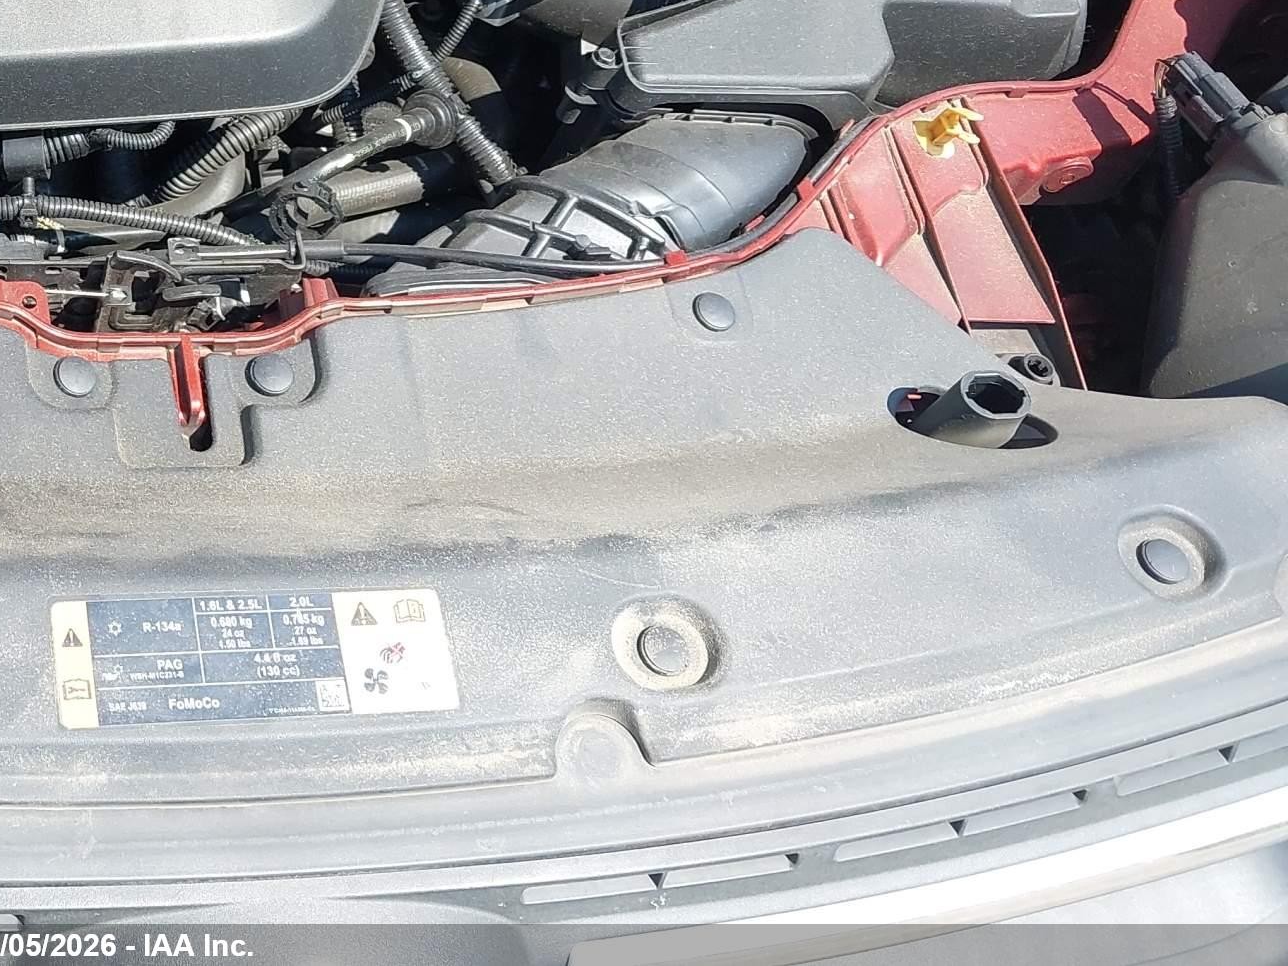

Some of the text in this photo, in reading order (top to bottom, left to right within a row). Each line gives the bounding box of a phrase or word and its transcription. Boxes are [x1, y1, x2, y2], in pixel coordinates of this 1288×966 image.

[199, 598, 263, 611] 1.6L & 2.5L
[289, 596, 314, 607] 2.0L
[238, 615, 253, 629] kg
[311, 613, 325, 627] kg
[142, 621, 182, 634] R-134a
[156, 658, 184, 671] PAG
[256, 664, 300, 678] (130 cc)
[168, 696, 220, 710] FoMoCo
